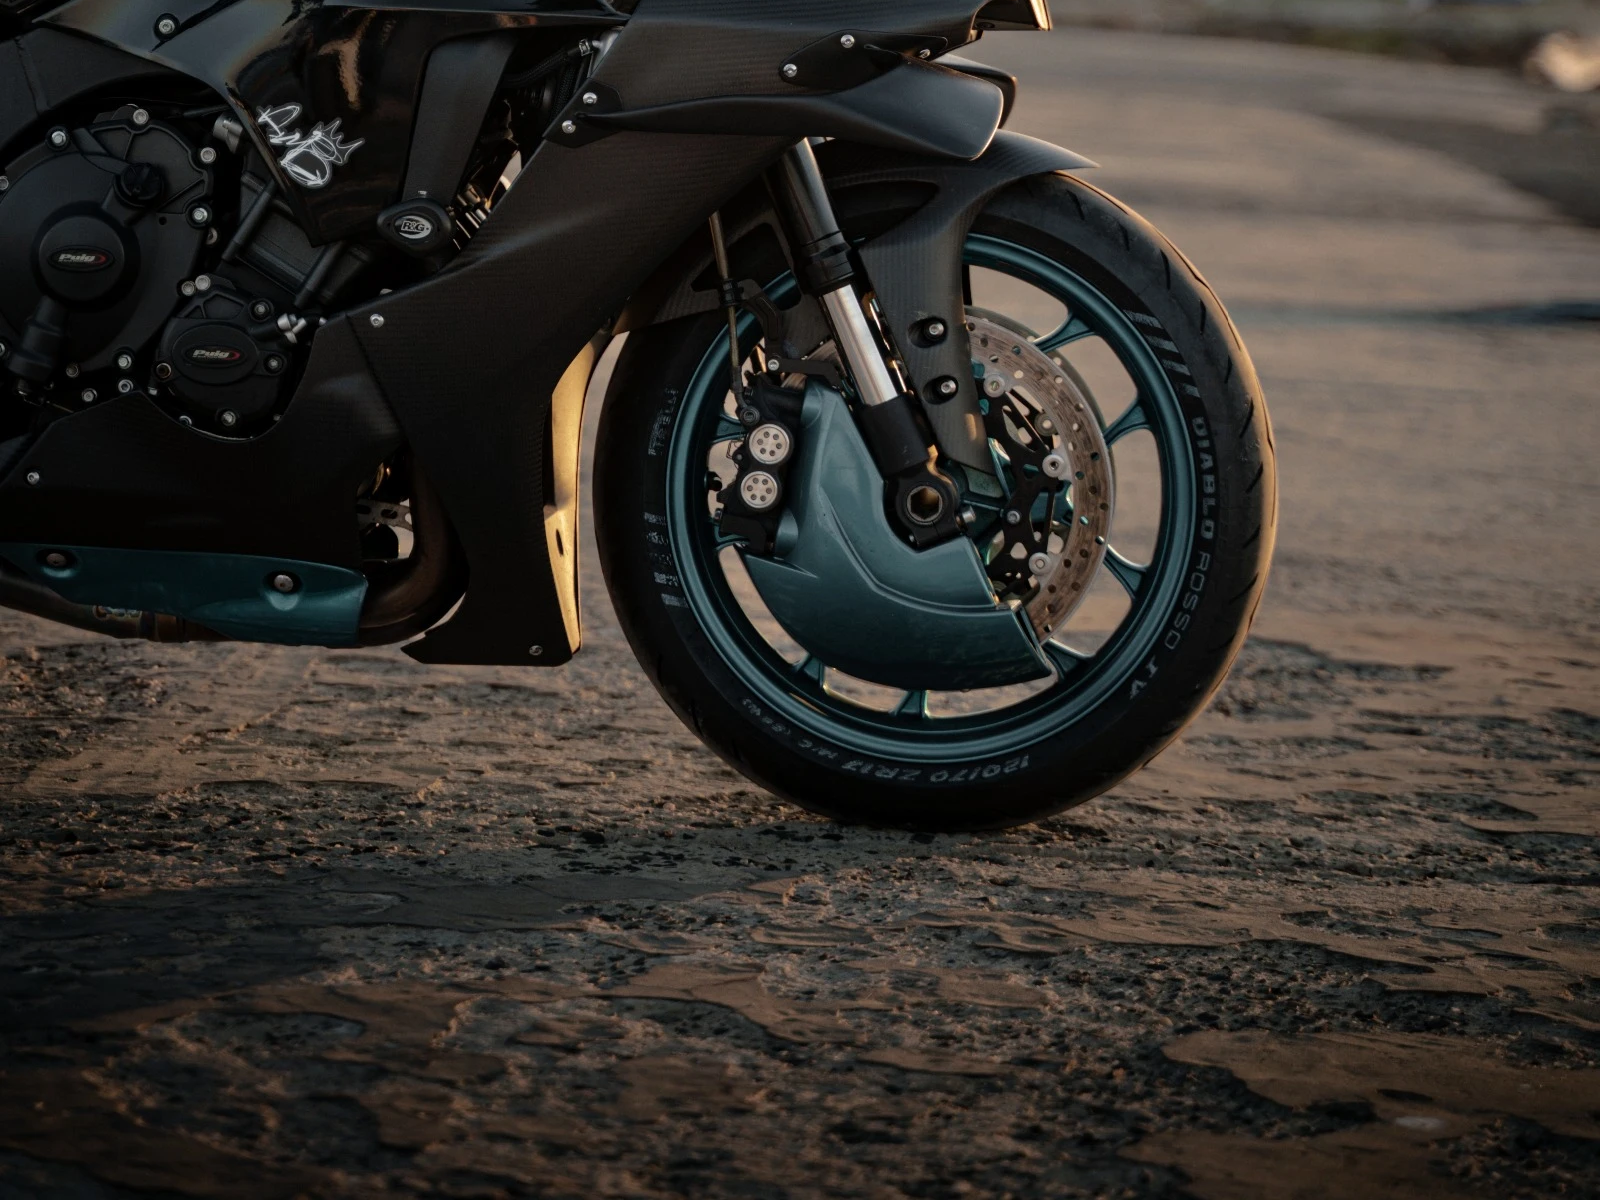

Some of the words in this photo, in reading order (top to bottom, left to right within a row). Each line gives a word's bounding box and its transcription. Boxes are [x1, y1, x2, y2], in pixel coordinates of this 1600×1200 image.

[401, 221, 425, 232] R&G
[59, 253, 96, 262] Puig
[193, 349, 230, 358] Puig
[1192, 416, 1215, 540] DIABLO
[1163, 550, 1211, 650] ROSSO
[840, 759, 923, 782] ZR17
[930, 754, 1031, 783] 120/70
